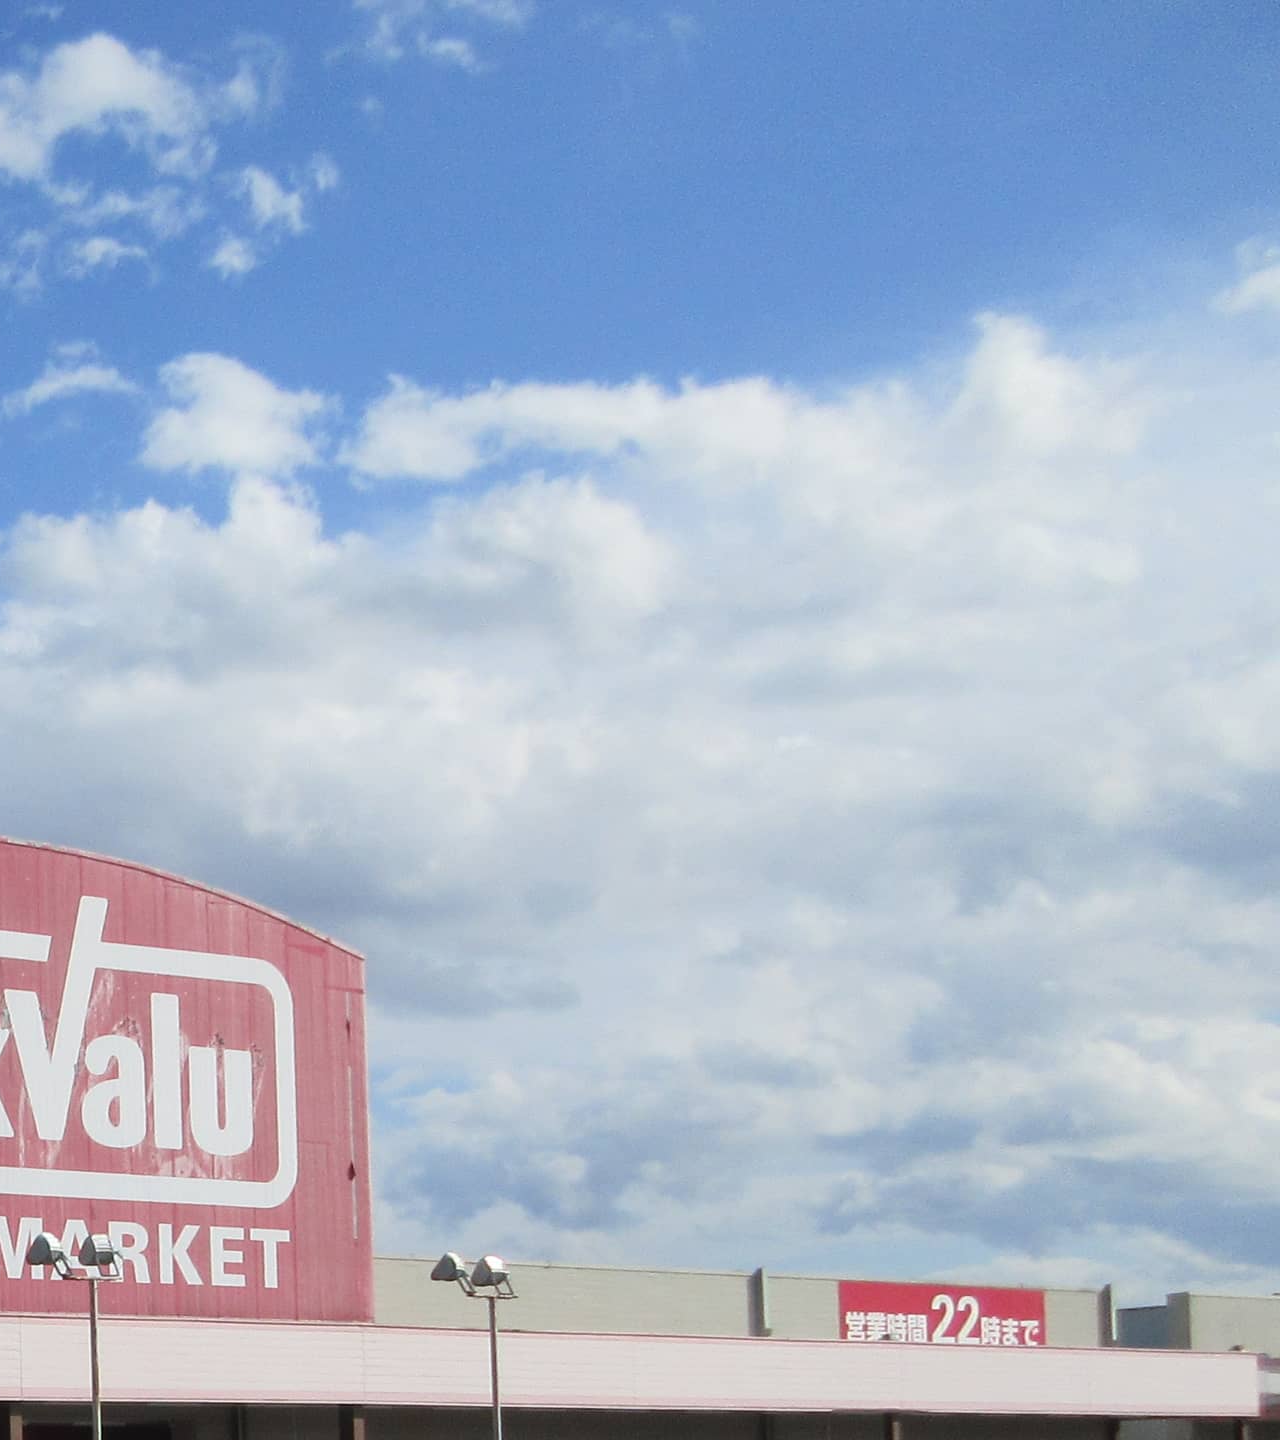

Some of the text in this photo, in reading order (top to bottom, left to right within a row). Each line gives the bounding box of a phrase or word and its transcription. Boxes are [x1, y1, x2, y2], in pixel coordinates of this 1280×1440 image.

[844, 1293, 1040, 1346] 営業時間22時まで
